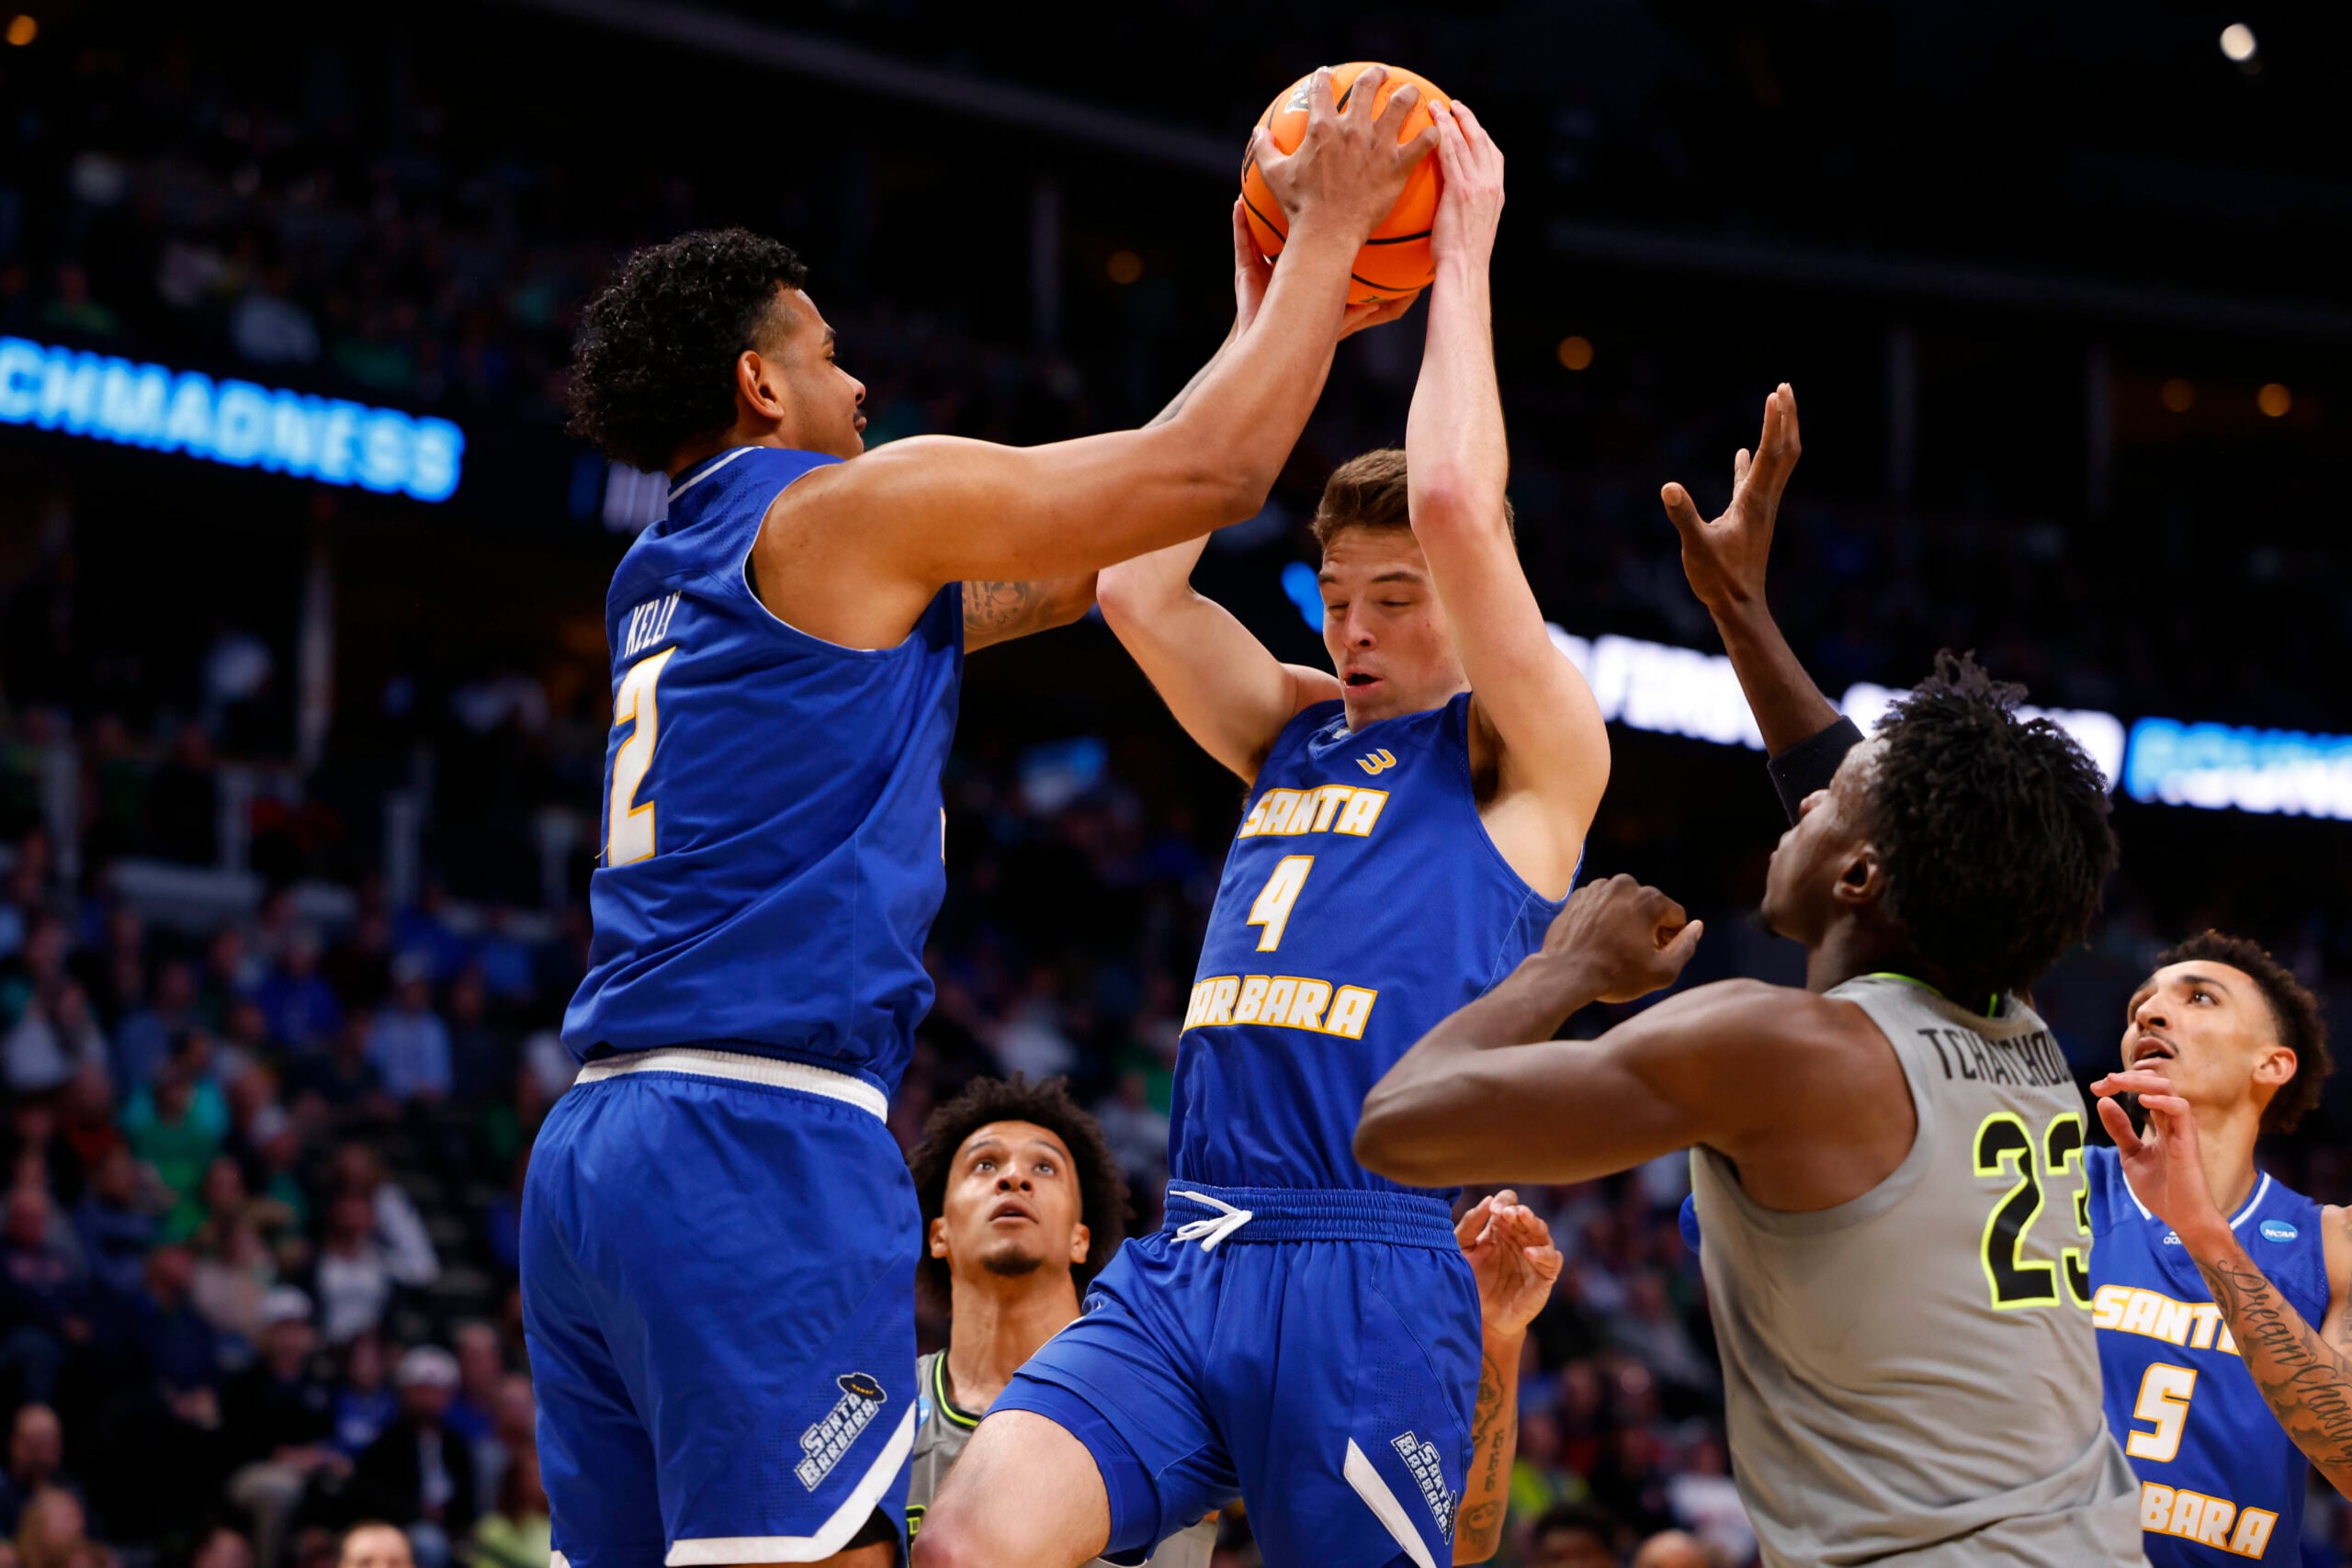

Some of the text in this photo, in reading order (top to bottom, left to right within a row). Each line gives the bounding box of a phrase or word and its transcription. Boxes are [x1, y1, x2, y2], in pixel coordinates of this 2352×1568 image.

[625, 590, 682, 658] KELLY
[608, 646, 677, 868] 2
[1238, 784, 1389, 840] SANTA
[1246, 855, 1315, 952] 4
[1973, 1111, 2095, 1311] 23
[2264, 1228, 2297, 1239] NCAA
[797, 1397, 876, 1489] BARBARA
[801, 1392, 863, 1458] SANTA
[2126, 1362, 2198, 1463] 5
[1393, 1432, 1449, 1532] BARBARA
[1418, 1443, 1452, 1515] SANTA
[2141, 1481, 2279, 1561] BARA
